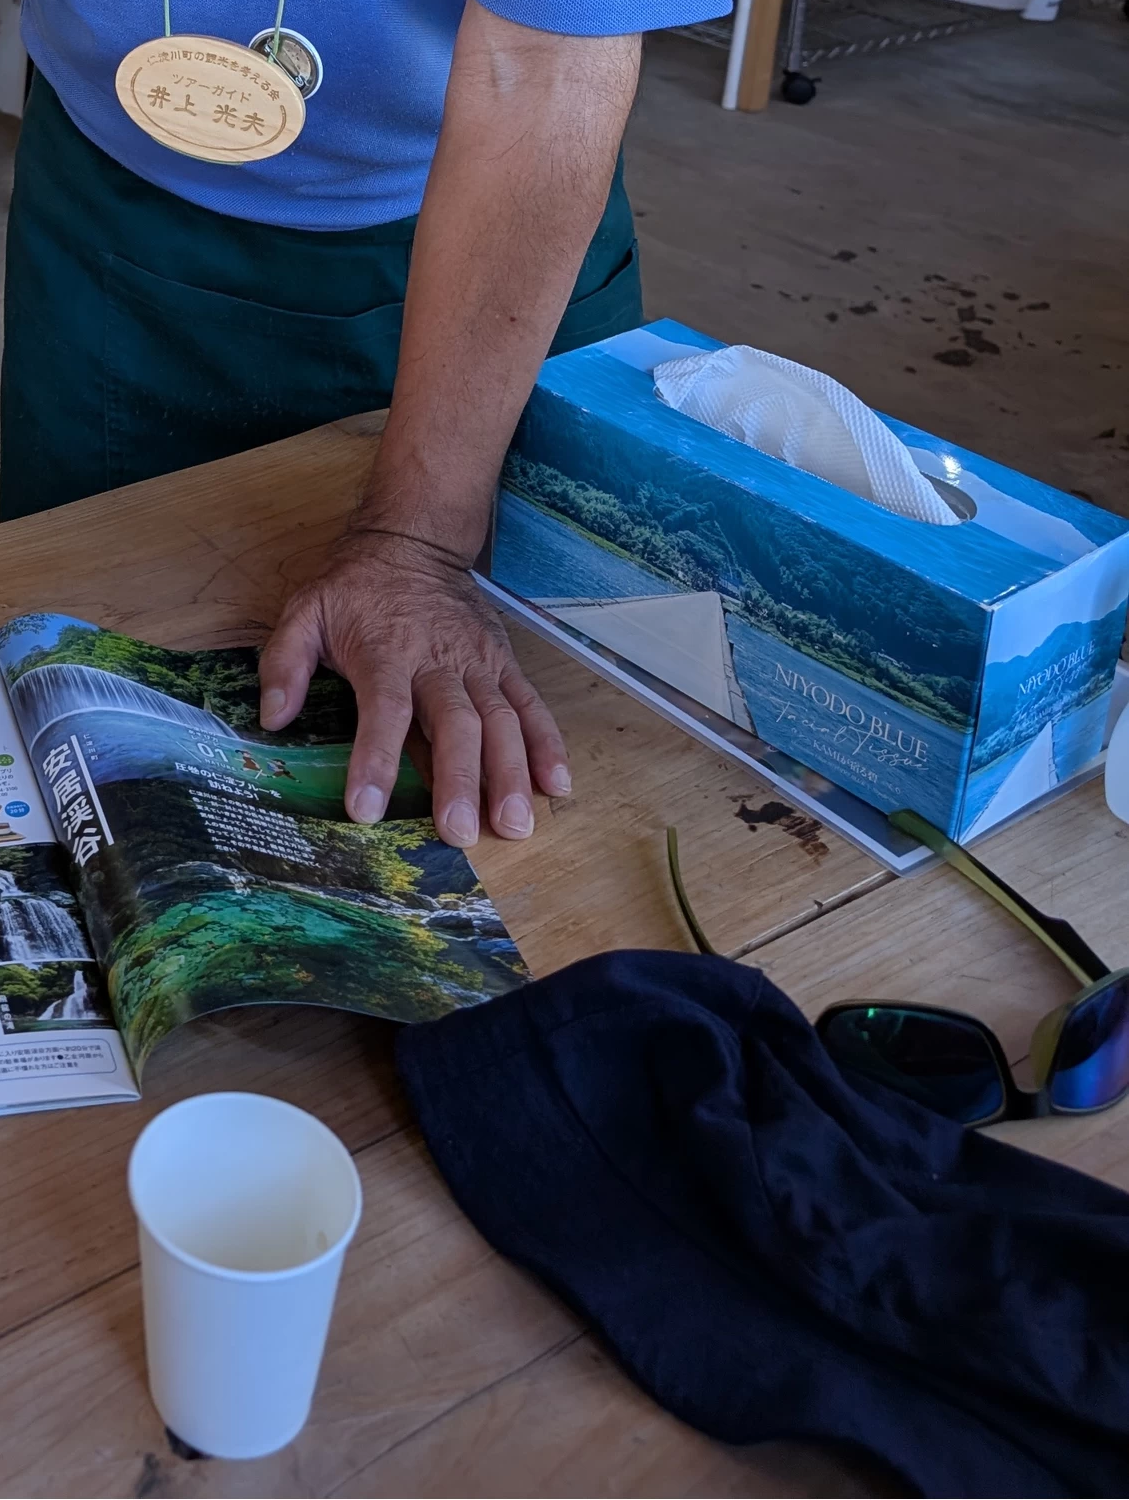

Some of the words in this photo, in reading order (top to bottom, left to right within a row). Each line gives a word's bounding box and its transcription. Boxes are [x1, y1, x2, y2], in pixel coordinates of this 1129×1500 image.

[146, 50, 282, 102] 仁淀川町の観光を考える会
[172, 73, 252, 103] ツアーガイド
[147, 85, 198, 117] 井上
[212, 104, 267, 136] 光夫
[775, 662, 866, 725] NIYODO
[871, 715, 929, 763] BLUE
[197, 742, 229, 763] 01
[848, 726, 929, 771] Tissue
[42, 742, 102, 868] 安居渓谷
